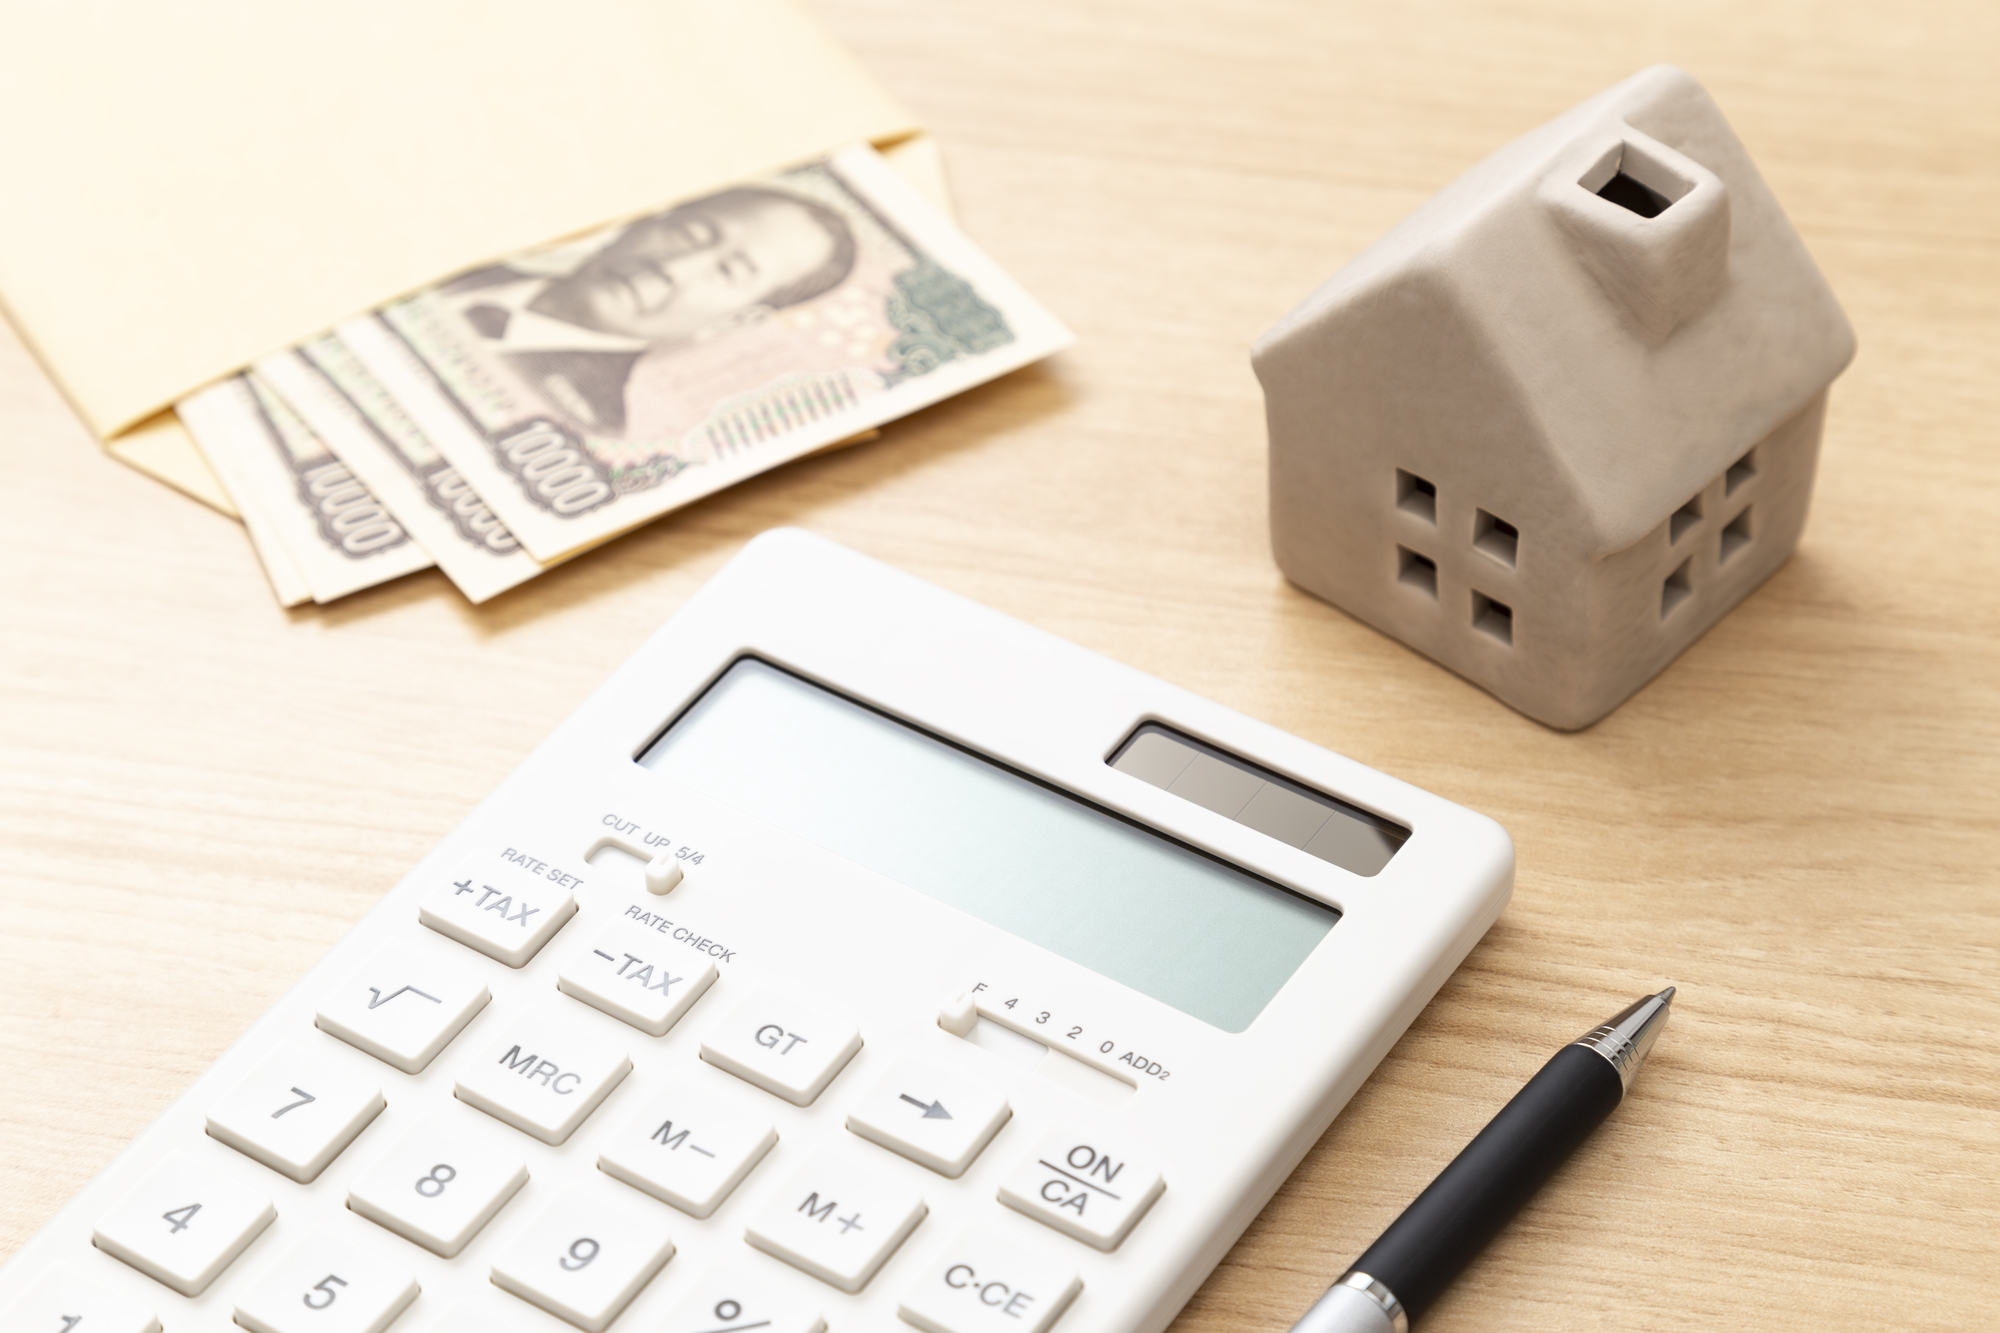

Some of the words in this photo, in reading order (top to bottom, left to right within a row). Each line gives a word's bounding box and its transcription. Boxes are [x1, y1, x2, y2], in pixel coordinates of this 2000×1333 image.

[499, 421, 611, 514] 10000
[602, 814, 641, 835] CUT
[643, 832, 670, 847] UP
[674, 846, 706, 867] 5/4
[501, 847, 547, 875] RATE
[547, 869, 584, 889] SET
[452, 879, 540, 928] +TAX
[624, 905, 674, 933] RATE
[673, 928, 736, 963] CHECK
[971, 982, 988, 993] F
[1004, 998, 1018, 1010] 4
[1035, 1011, 1051, 1024] 3
[1066, 1026, 1083, 1040] 2
[754, 1024, 808, 1055] GT
[498, 1044, 581, 1095] MRC
[271, 1086, 316, 1119] 7
[415, 1163, 457, 1198] 8
[1066, 1145, 1125, 1184] ON
[162, 1203, 202, 1234] 4
[797, 1191, 864, 1234] M+
[1040, 1180, 1091, 1217] CA
[559, 1237, 601, 1272] 9
[302, 1274, 349, 1310] 5
